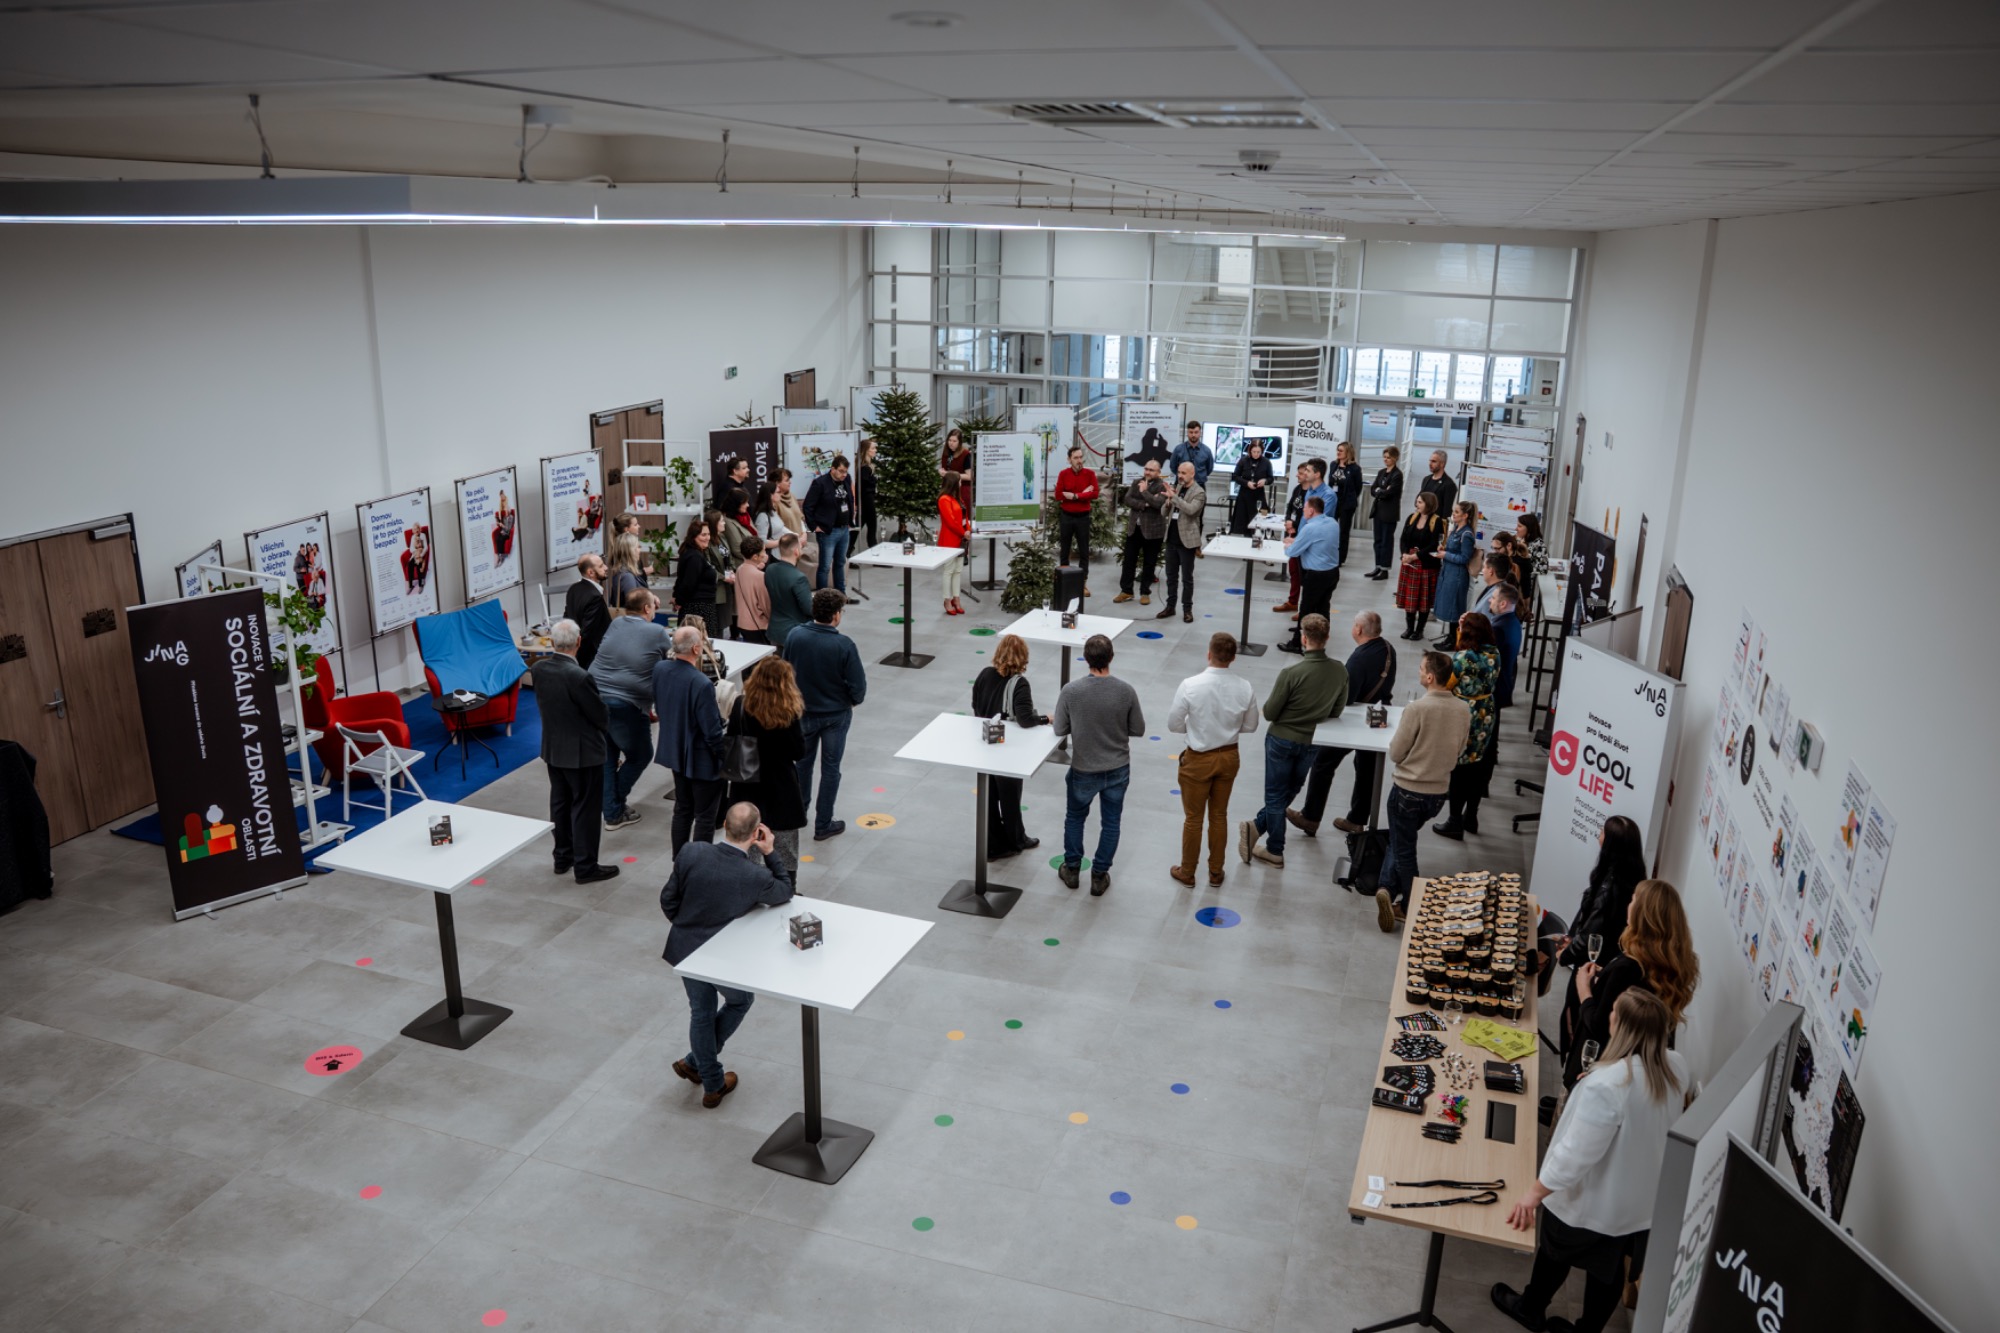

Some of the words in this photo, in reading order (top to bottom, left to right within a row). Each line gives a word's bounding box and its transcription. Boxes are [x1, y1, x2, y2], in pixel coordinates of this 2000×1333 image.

[1458, 403, 1474, 411] WC
[1297, 428, 1334, 442] REGION
[1298, 418, 1326, 431] COOL
[715, 451, 737, 463] JINA
[754, 441, 769, 493] ŽIVOT
[371, 512, 392, 523] Domov
[260, 540, 285, 553] Všichni
[247, 613, 263, 662] INOVACE
[255, 663, 265, 672] V
[225, 616, 261, 718] SOCIÁLNÍ
[240, 721, 258, 740] A
[1586, 726, 1597, 736] pro
[1554, 740, 1572, 766] C
[1582, 745, 1634, 790] COOL
[1578, 768, 1616, 805] LIFE
[244, 742, 282, 857] ZDRAVOTNÍ
[241, 817, 257, 862] OBLASTI
